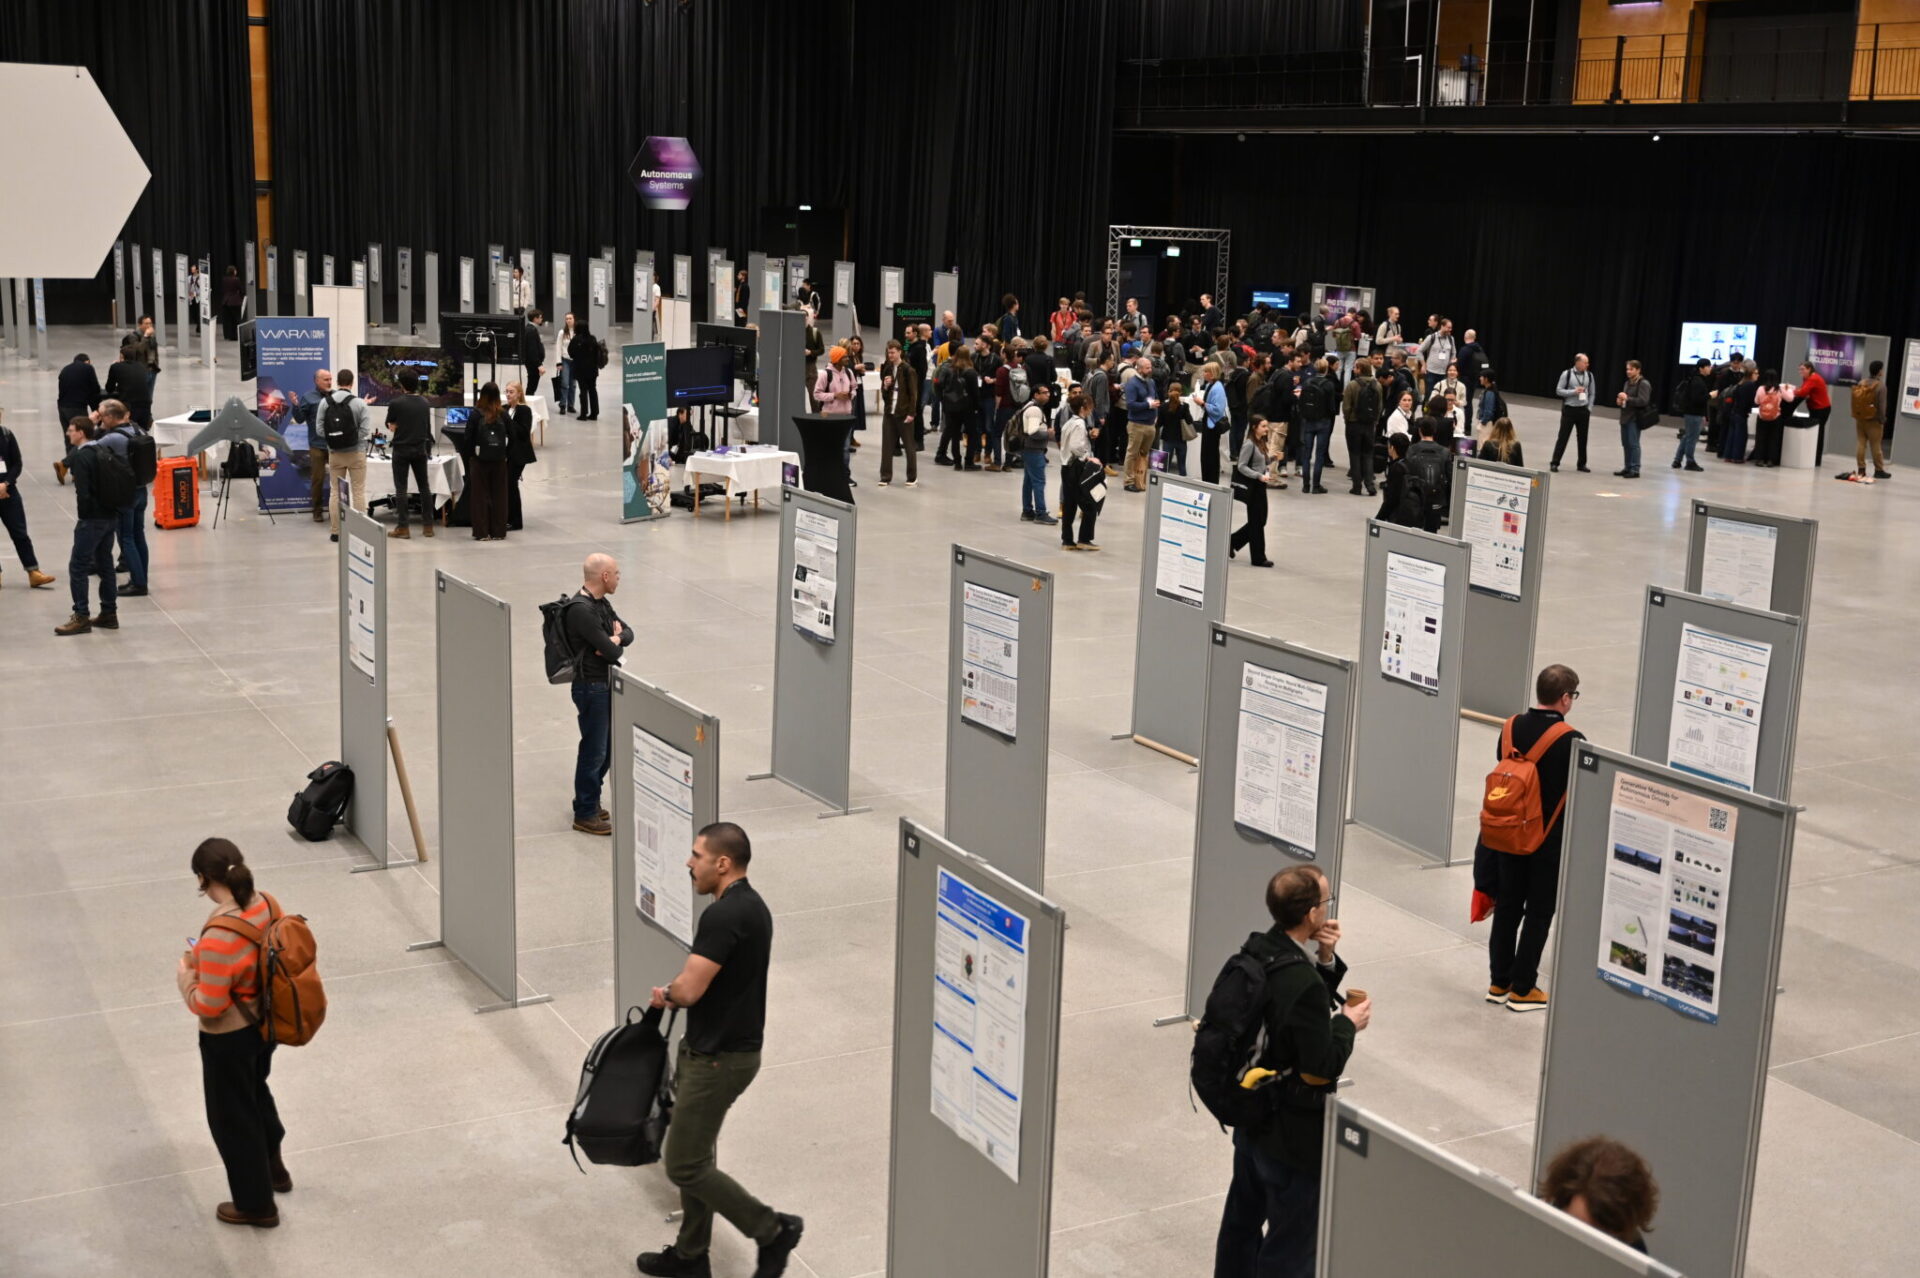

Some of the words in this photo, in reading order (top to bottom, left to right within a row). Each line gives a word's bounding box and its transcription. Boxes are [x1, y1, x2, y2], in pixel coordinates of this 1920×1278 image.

[641, 169, 692, 179] Autonomous
[649, 180, 684, 190] Systems
[260, 329, 310, 339] WARA
[625, 353, 654, 366] WARA
[1583, 755, 1594, 765] 57
[1619, 778, 1647, 791] Generative
[1648, 786, 1670, 799] Methods
[1620, 785, 1651, 799] Autonomous
[1651, 794, 1671, 807] Driving
